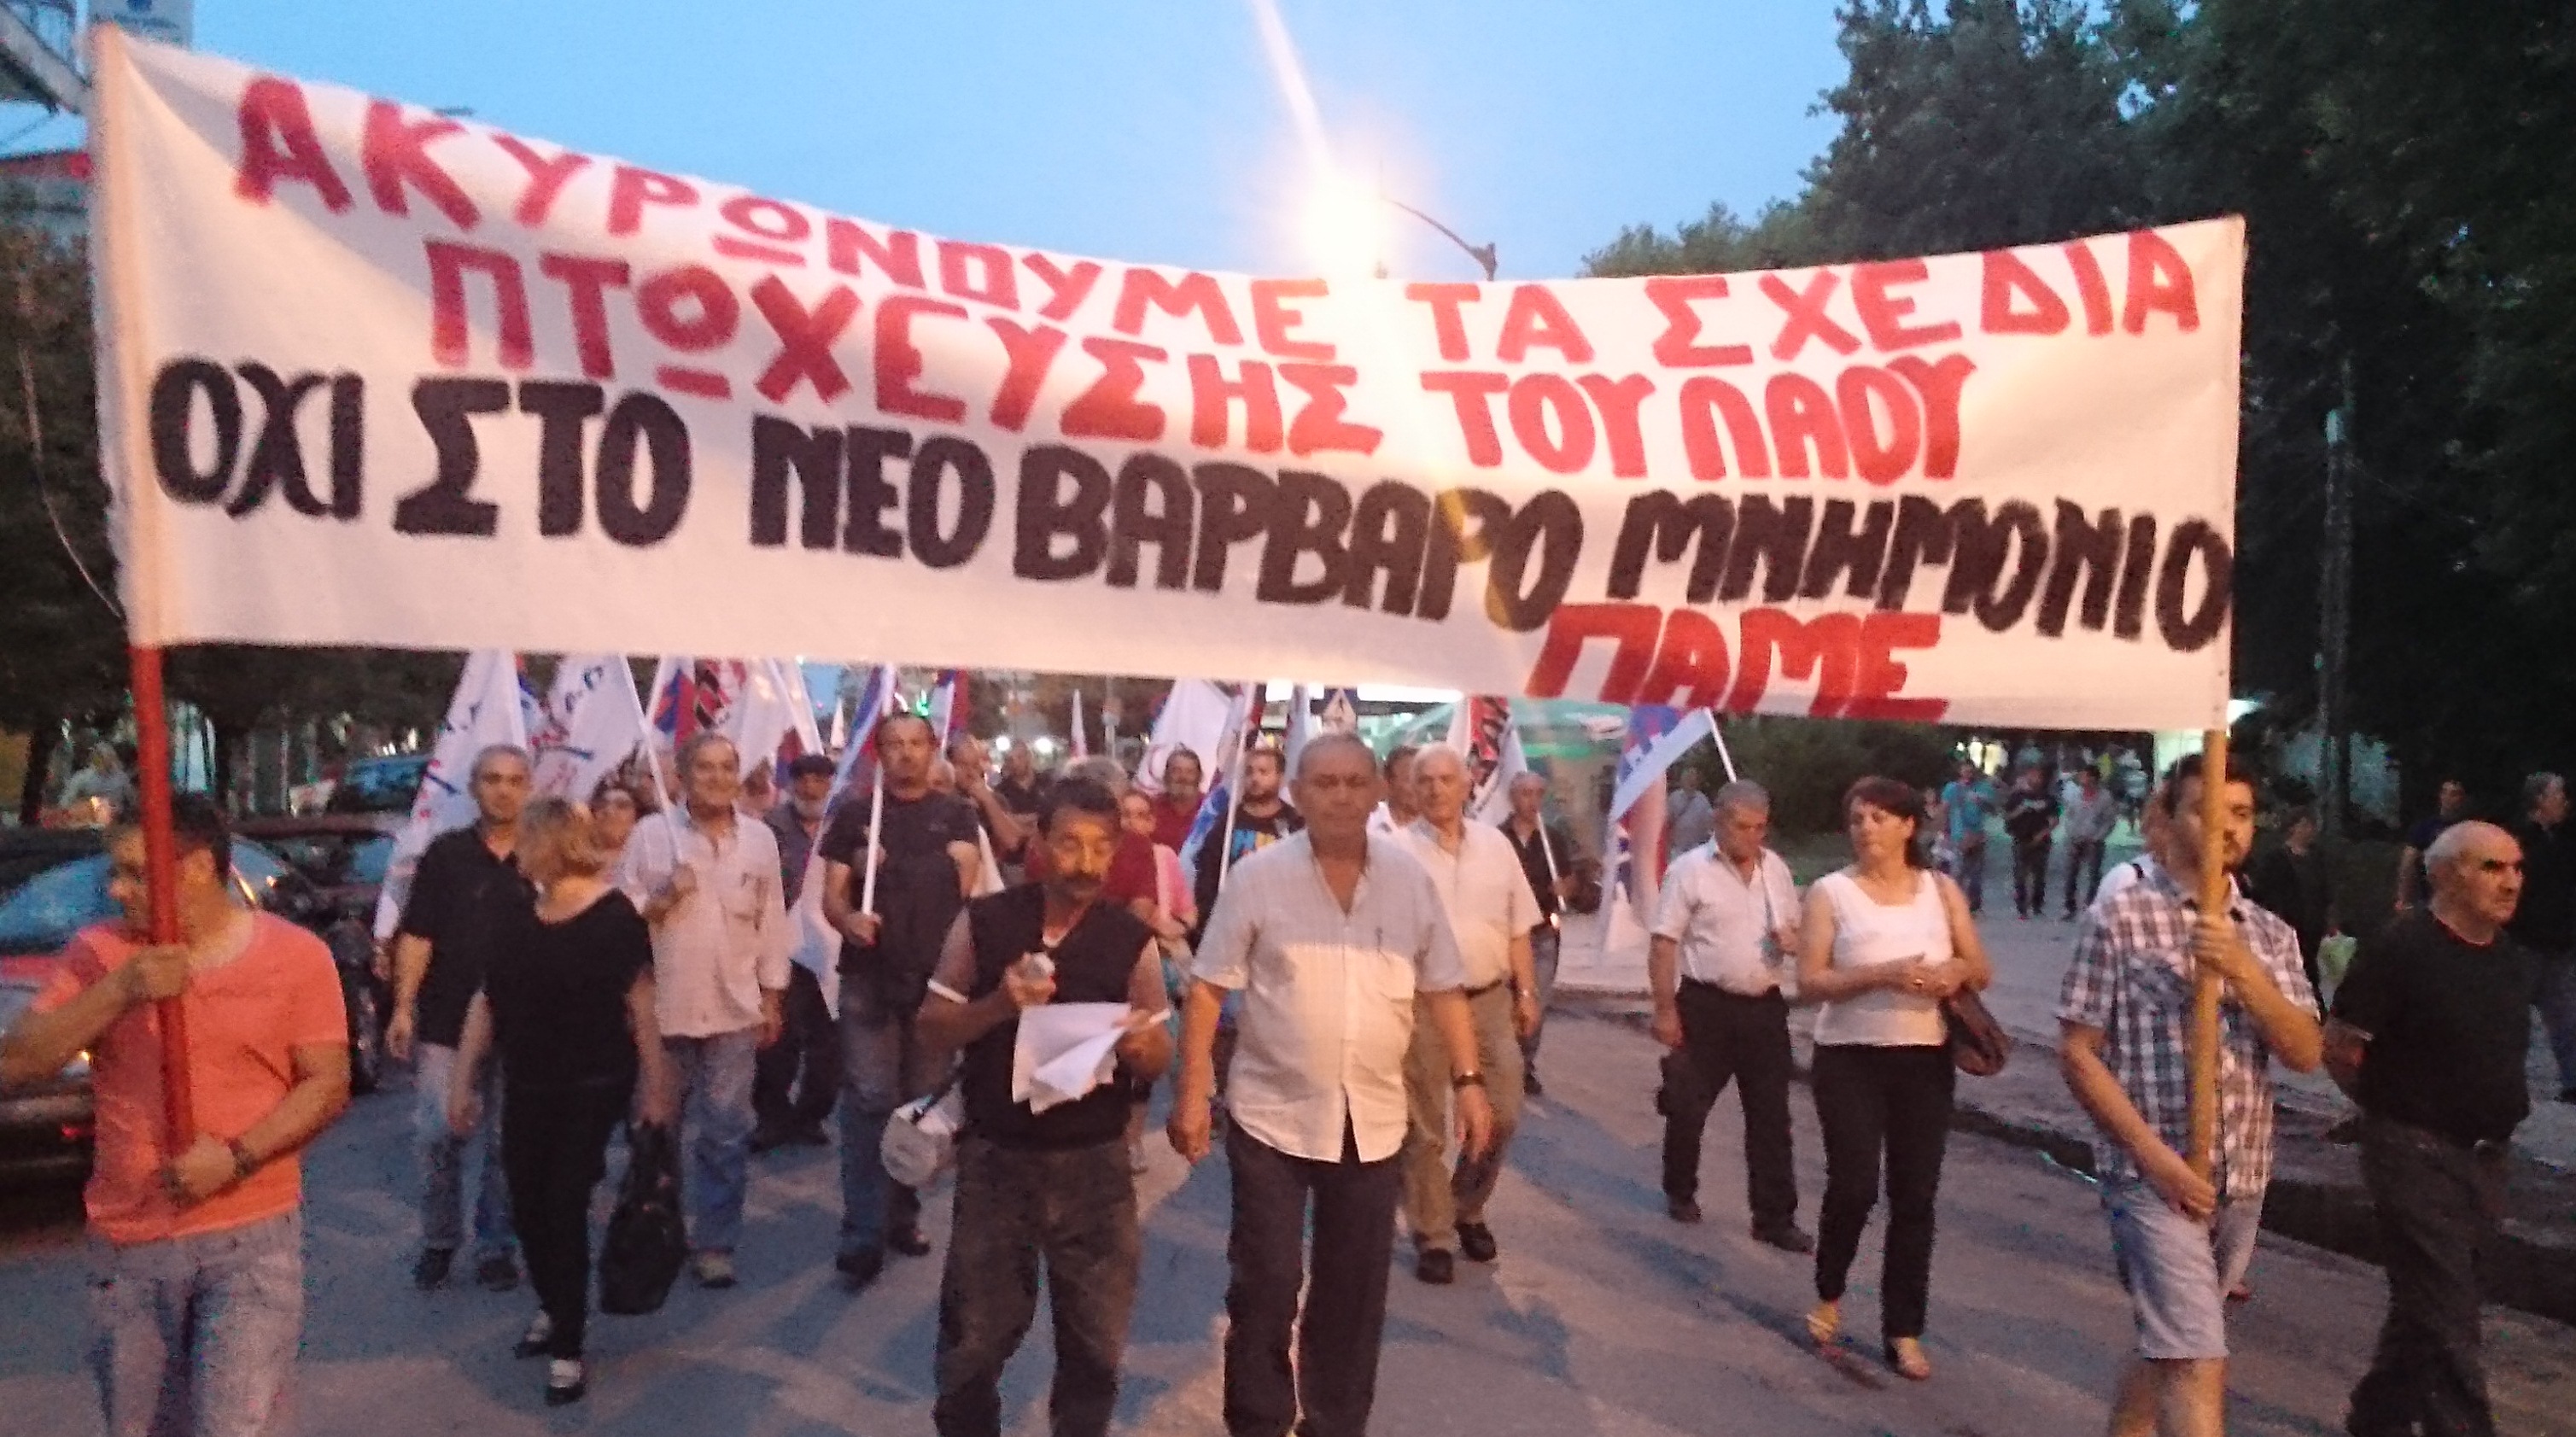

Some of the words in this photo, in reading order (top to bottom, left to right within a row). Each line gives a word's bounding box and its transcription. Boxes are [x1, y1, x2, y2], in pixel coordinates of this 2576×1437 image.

[232, 77, 1337, 360] ΑΚΥΡΩΝΟΥΜΕ
[1406, 283, 1595, 365] ΤΑ
[1644, 228, 2201, 368] ΣΧΕΔΙΑ
[424, 238, 1384, 456] ΠΤΩΧΕΥΣΗΣ
[1421, 371, 1656, 478] ΤΟΥ
[149, 357, 365, 521] ΟΧΙ
[393, 377, 693, 547] ΣΤΟ
[749, 413, 997, 570] ΝΕΟ
[1013, 444, 1585, 634] ΒΑΡΒΑΡΟ
[1607, 488, 2234, 651] ΜΝΗΜΟΝΙΟ
[1527, 601, 1951, 723] ΠΑΜΕ
